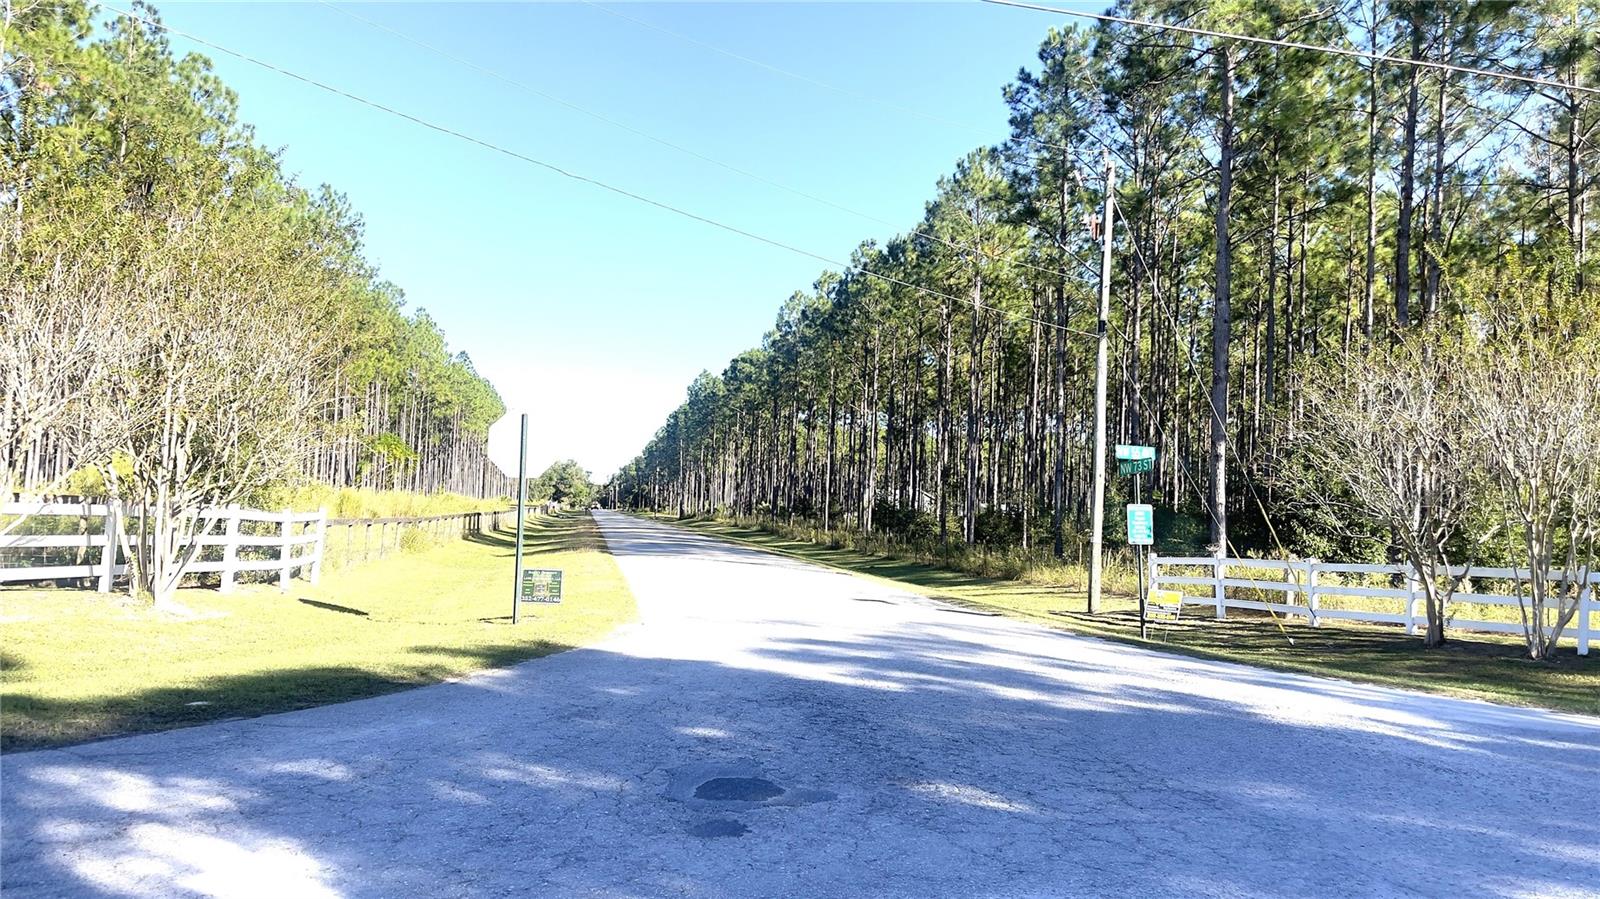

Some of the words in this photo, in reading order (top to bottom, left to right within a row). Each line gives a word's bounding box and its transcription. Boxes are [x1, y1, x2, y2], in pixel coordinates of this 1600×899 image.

[1120, 463, 1132, 475] NW
[1133, 461, 1142, 472] 73
[1143, 459, 1152, 470] ST
